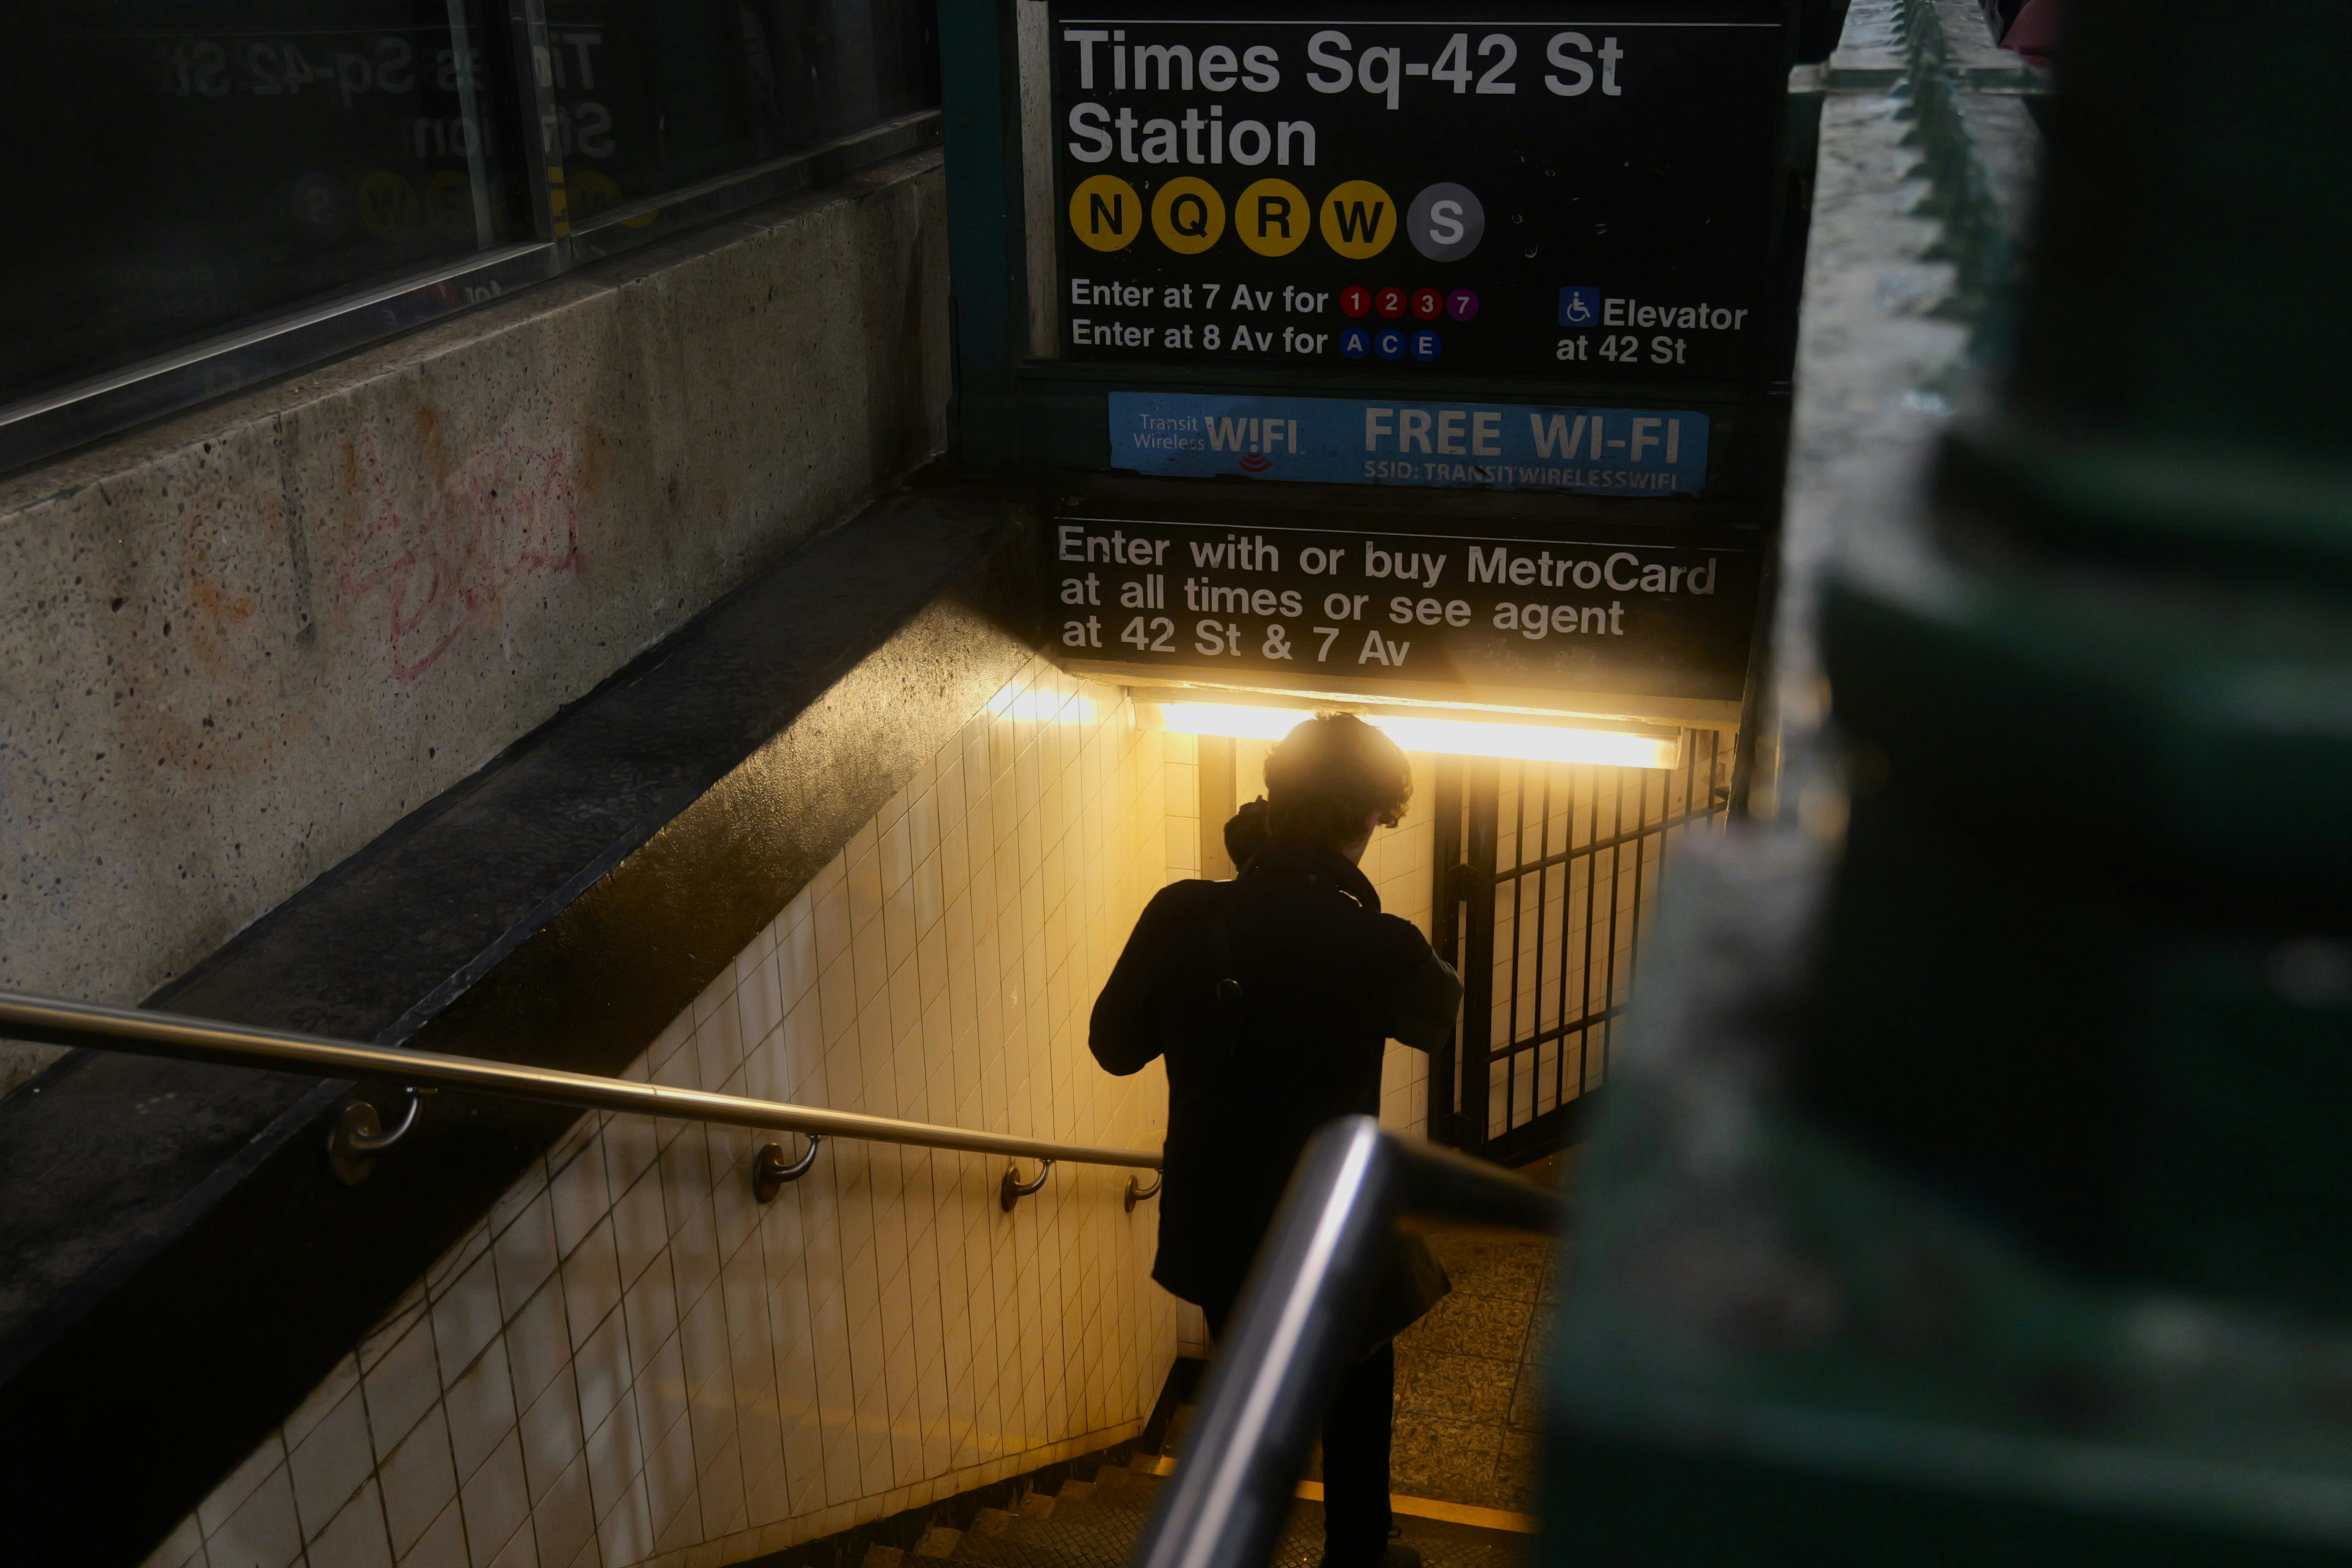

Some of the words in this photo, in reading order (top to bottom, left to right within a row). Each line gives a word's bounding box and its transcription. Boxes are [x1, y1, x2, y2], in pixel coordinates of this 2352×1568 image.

[1064, 30, 1279, 92] Times
[1307, 31, 1517, 109] Sq-42
[1545, 32, 1623, 96] St
[1069, 103, 1315, 165] Station
[1091, 194, 1122, 234] N
[1171, 194, 1207, 238] Q
[1258, 196, 1290, 238] R
[1334, 201, 1384, 243] W
[1430, 200, 1463, 244] S
[1072, 279, 1153, 306] Enter
[1164, 284, 1192, 308] at
[1203, 284, 1220, 309] 7
[1231, 284, 1273, 310] Av
[1283, 286, 1328, 312] for
[1351, 293, 1359, 310] 1
[1386, 293, 1397, 310] 2
[1422, 295, 1433, 312] 3
[1457, 297, 1469, 314] 7
[1604, 299, 1747, 329] Elevator
[1073, 319, 1154, 346] Enter
[1165, 325, 1192, 348] at
[1203, 325, 1220, 350] 8
[1231, 325, 1273, 351] Av
[1283, 327, 1328, 353] for
[1347, 335, 1362, 351] A
[1383, 336, 1397, 353] C
[1419, 337, 1432, 354] E
[1557, 336, 1588, 360] at
[1599, 335, 1638, 362] 42
[1651, 336, 1686, 364] St
[1134, 433, 1204, 450] Wireless
[1140, 414, 1198, 431] Transit
[1366, 408, 1501, 456] FREE
[1530, 414, 1679, 463] WI-FI
[1365, 461, 1418, 479] SSID:
[1059, 526, 1170, 566] Enter
[1190, 534, 1278, 571] with
[1300, 548, 1344, 574] or
[1366, 541, 1446, 588] buy
[1468, 545, 1717, 595] MetroCard
[1061, 573, 1100, 605] at
[1121, 574, 1164, 609] all
[1185, 577, 1302, 617] times
[1324, 593, 1368, 620] or
[1389, 597, 1471, 626] see
[1493, 601, 1624, 639] agent
[1063, 616, 1102, 647] at
[1122, 617, 1175, 652] 42
[1195, 620, 1241, 656] St
[1262, 624, 1292, 659] &
[1314, 627, 1339, 662] 7
[1359, 631, 1410, 666] Av
